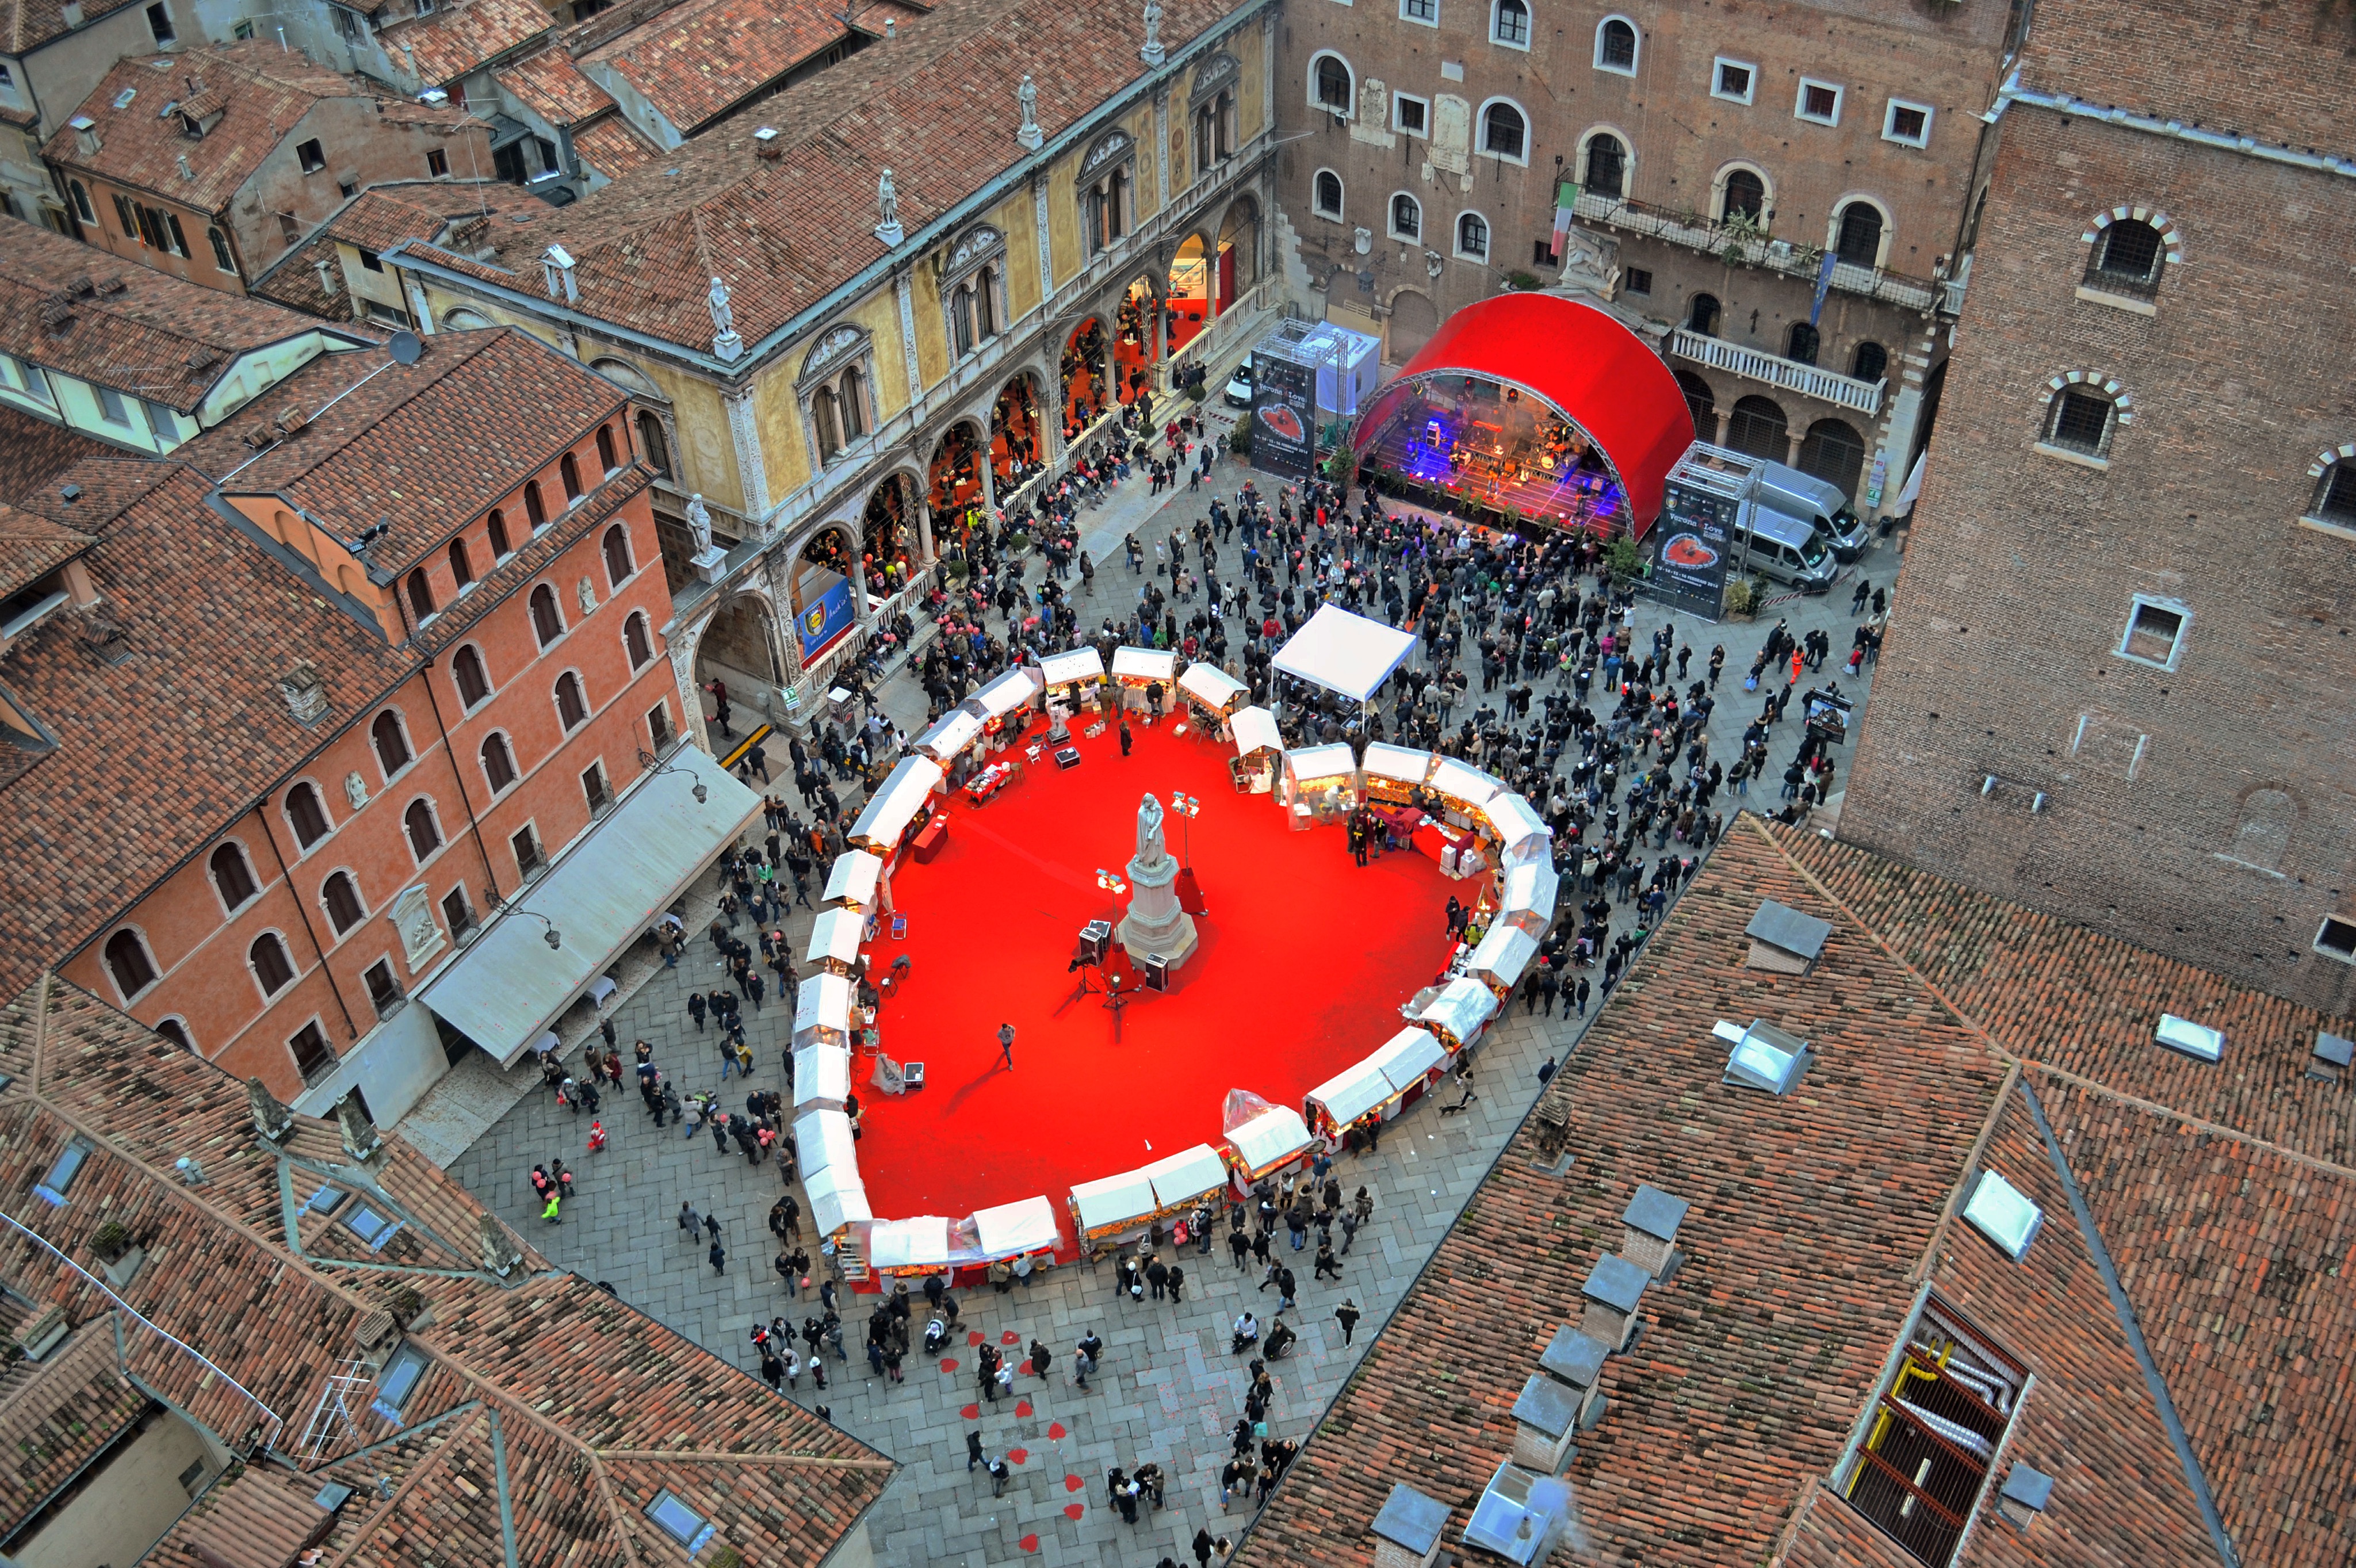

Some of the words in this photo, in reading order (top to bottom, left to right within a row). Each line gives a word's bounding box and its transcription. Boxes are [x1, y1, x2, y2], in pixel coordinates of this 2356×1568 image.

[1259, 383, 1283, 396] Verona
[1288, 391, 1306, 402] Love
[1669, 513, 1697, 527] Verona
[1703, 522, 1724, 535] Love
[1810, 718, 1822, 726] GEO
